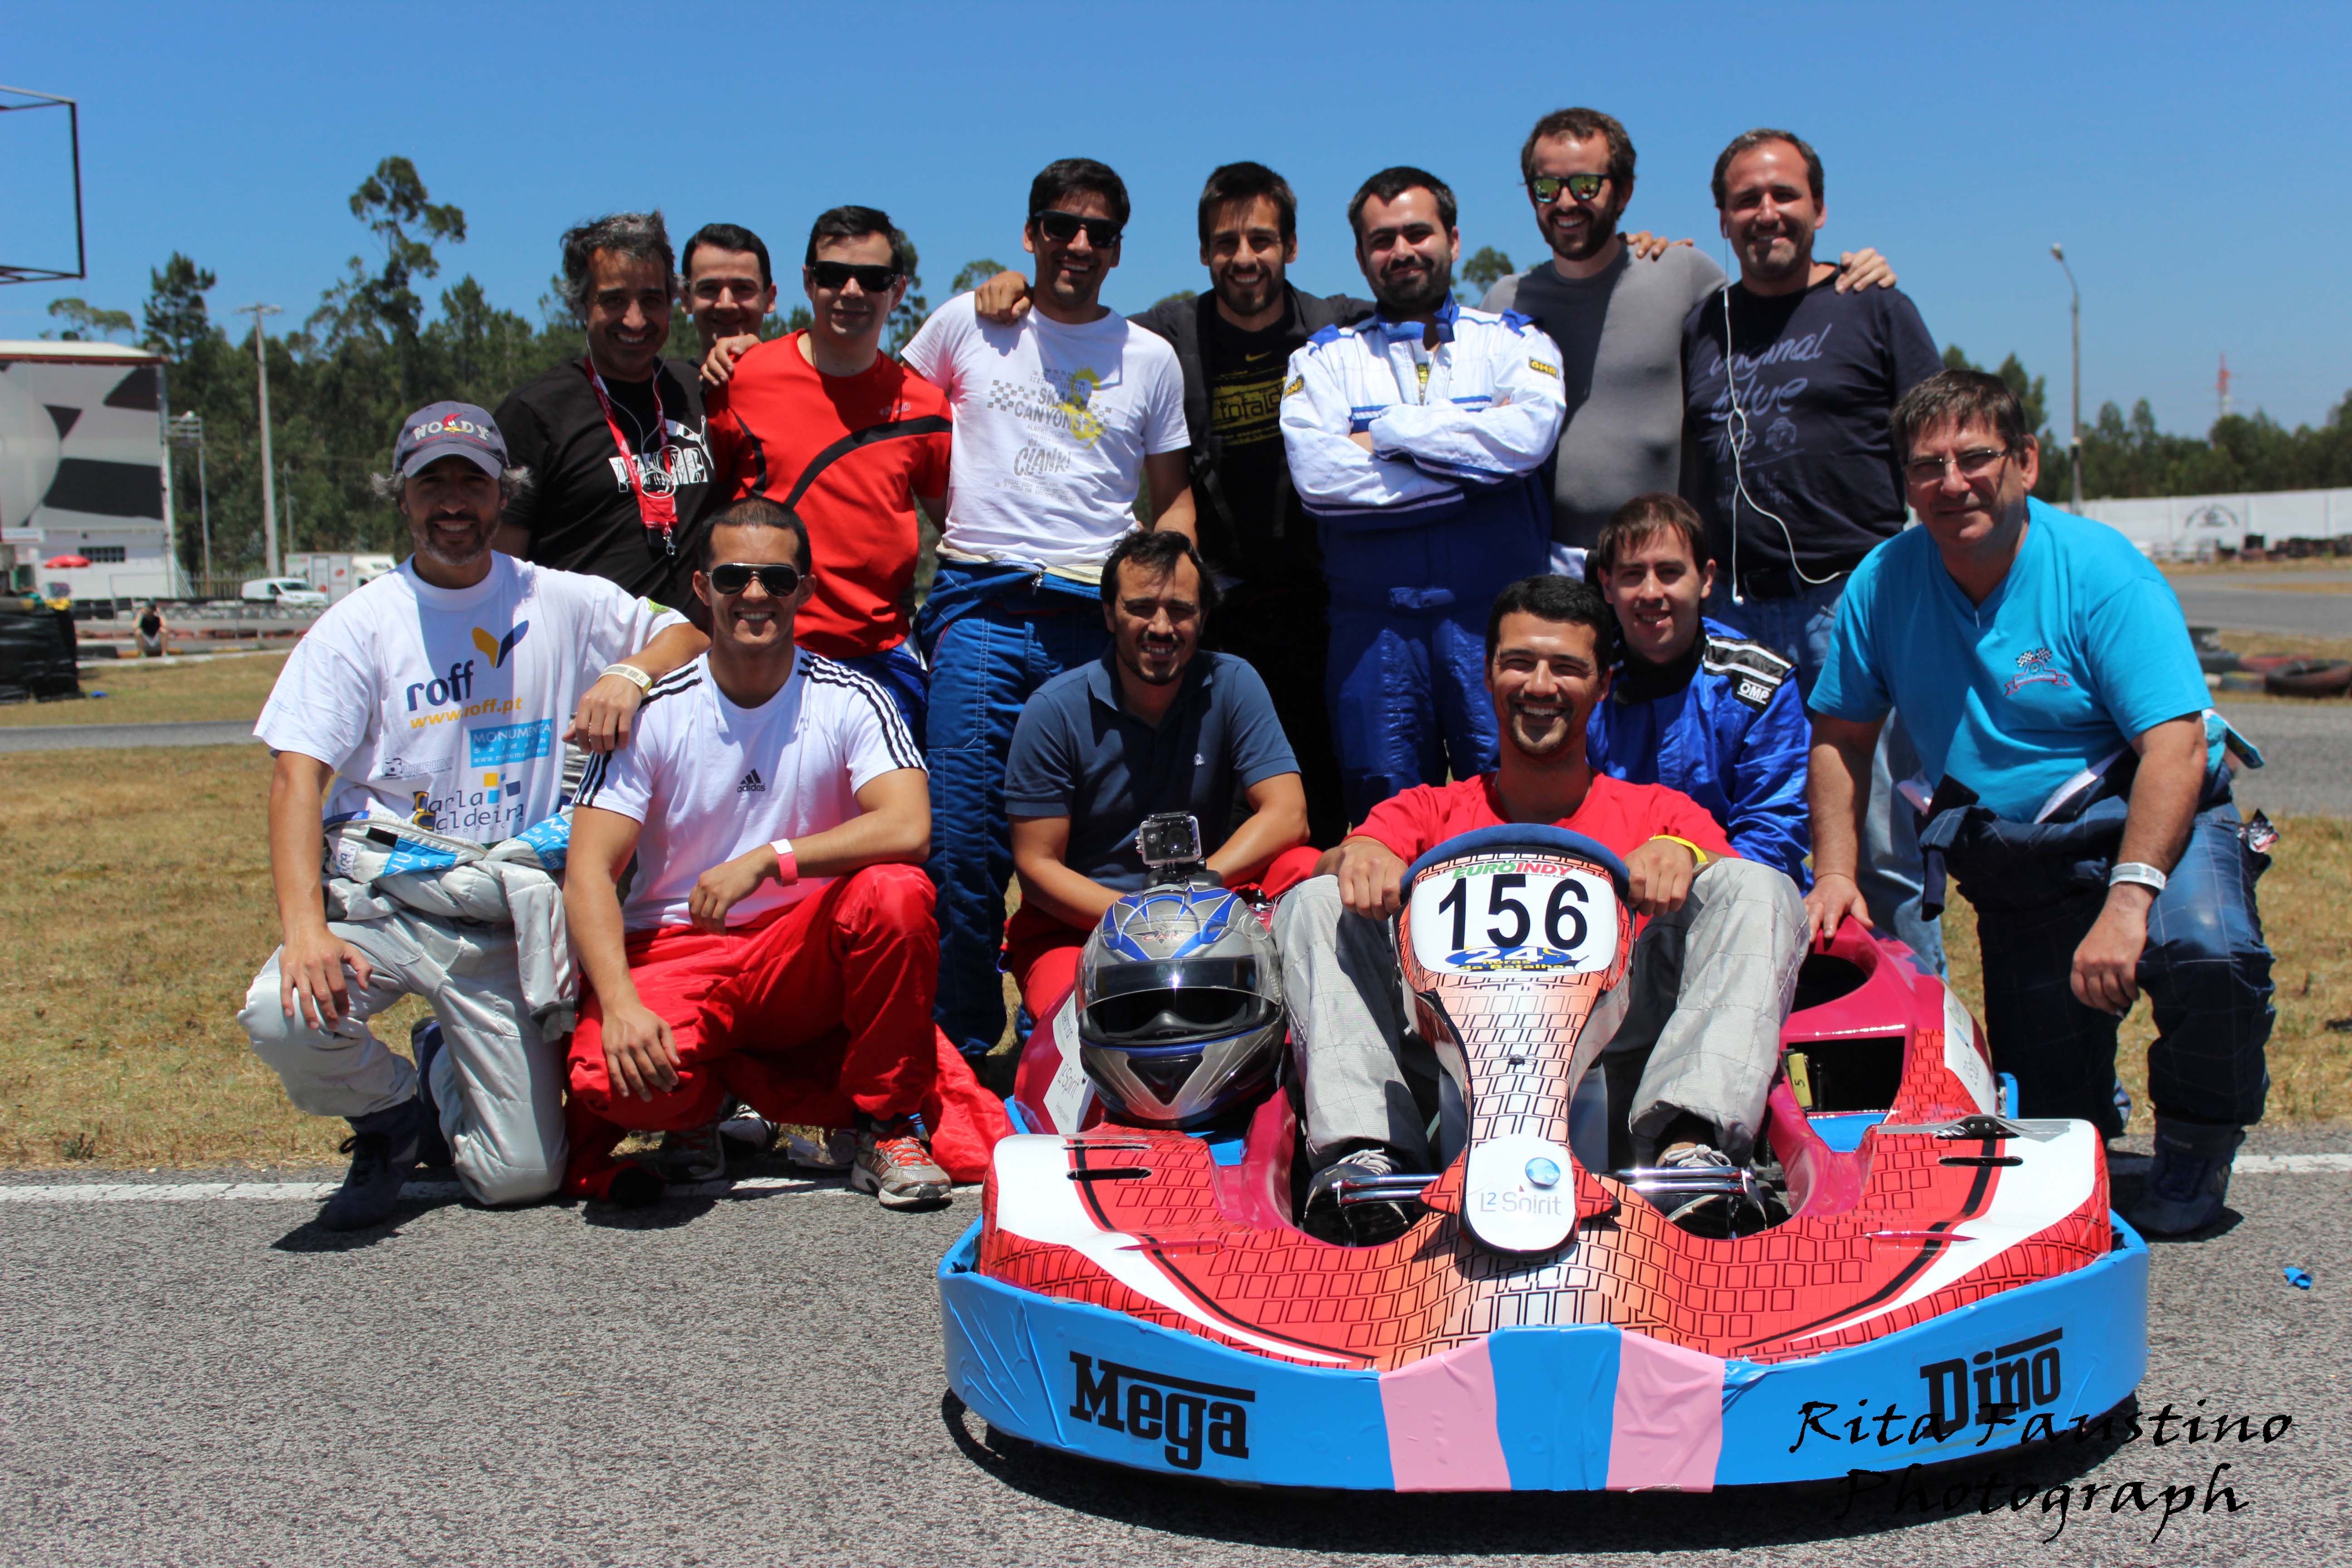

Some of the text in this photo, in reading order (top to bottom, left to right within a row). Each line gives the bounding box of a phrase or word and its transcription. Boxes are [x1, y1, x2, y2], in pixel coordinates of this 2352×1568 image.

[1014, 399, 1082, 431] CANYONS
[413, 420, 490, 441] WODY
[407, 659, 474, 711] roff
[1739, 682, 1770, 701] OMP
[737, 783, 766, 793] adidas
[412, 790, 483, 813] Carla
[1452, 862, 1573, 880] EUROINDY
[1439, 874, 1589, 951] 156
[1465, 947, 1544, 964] 24
[1920, 1327, 2063, 1439] Dino
[1069, 1350, 1256, 1470] Mega
